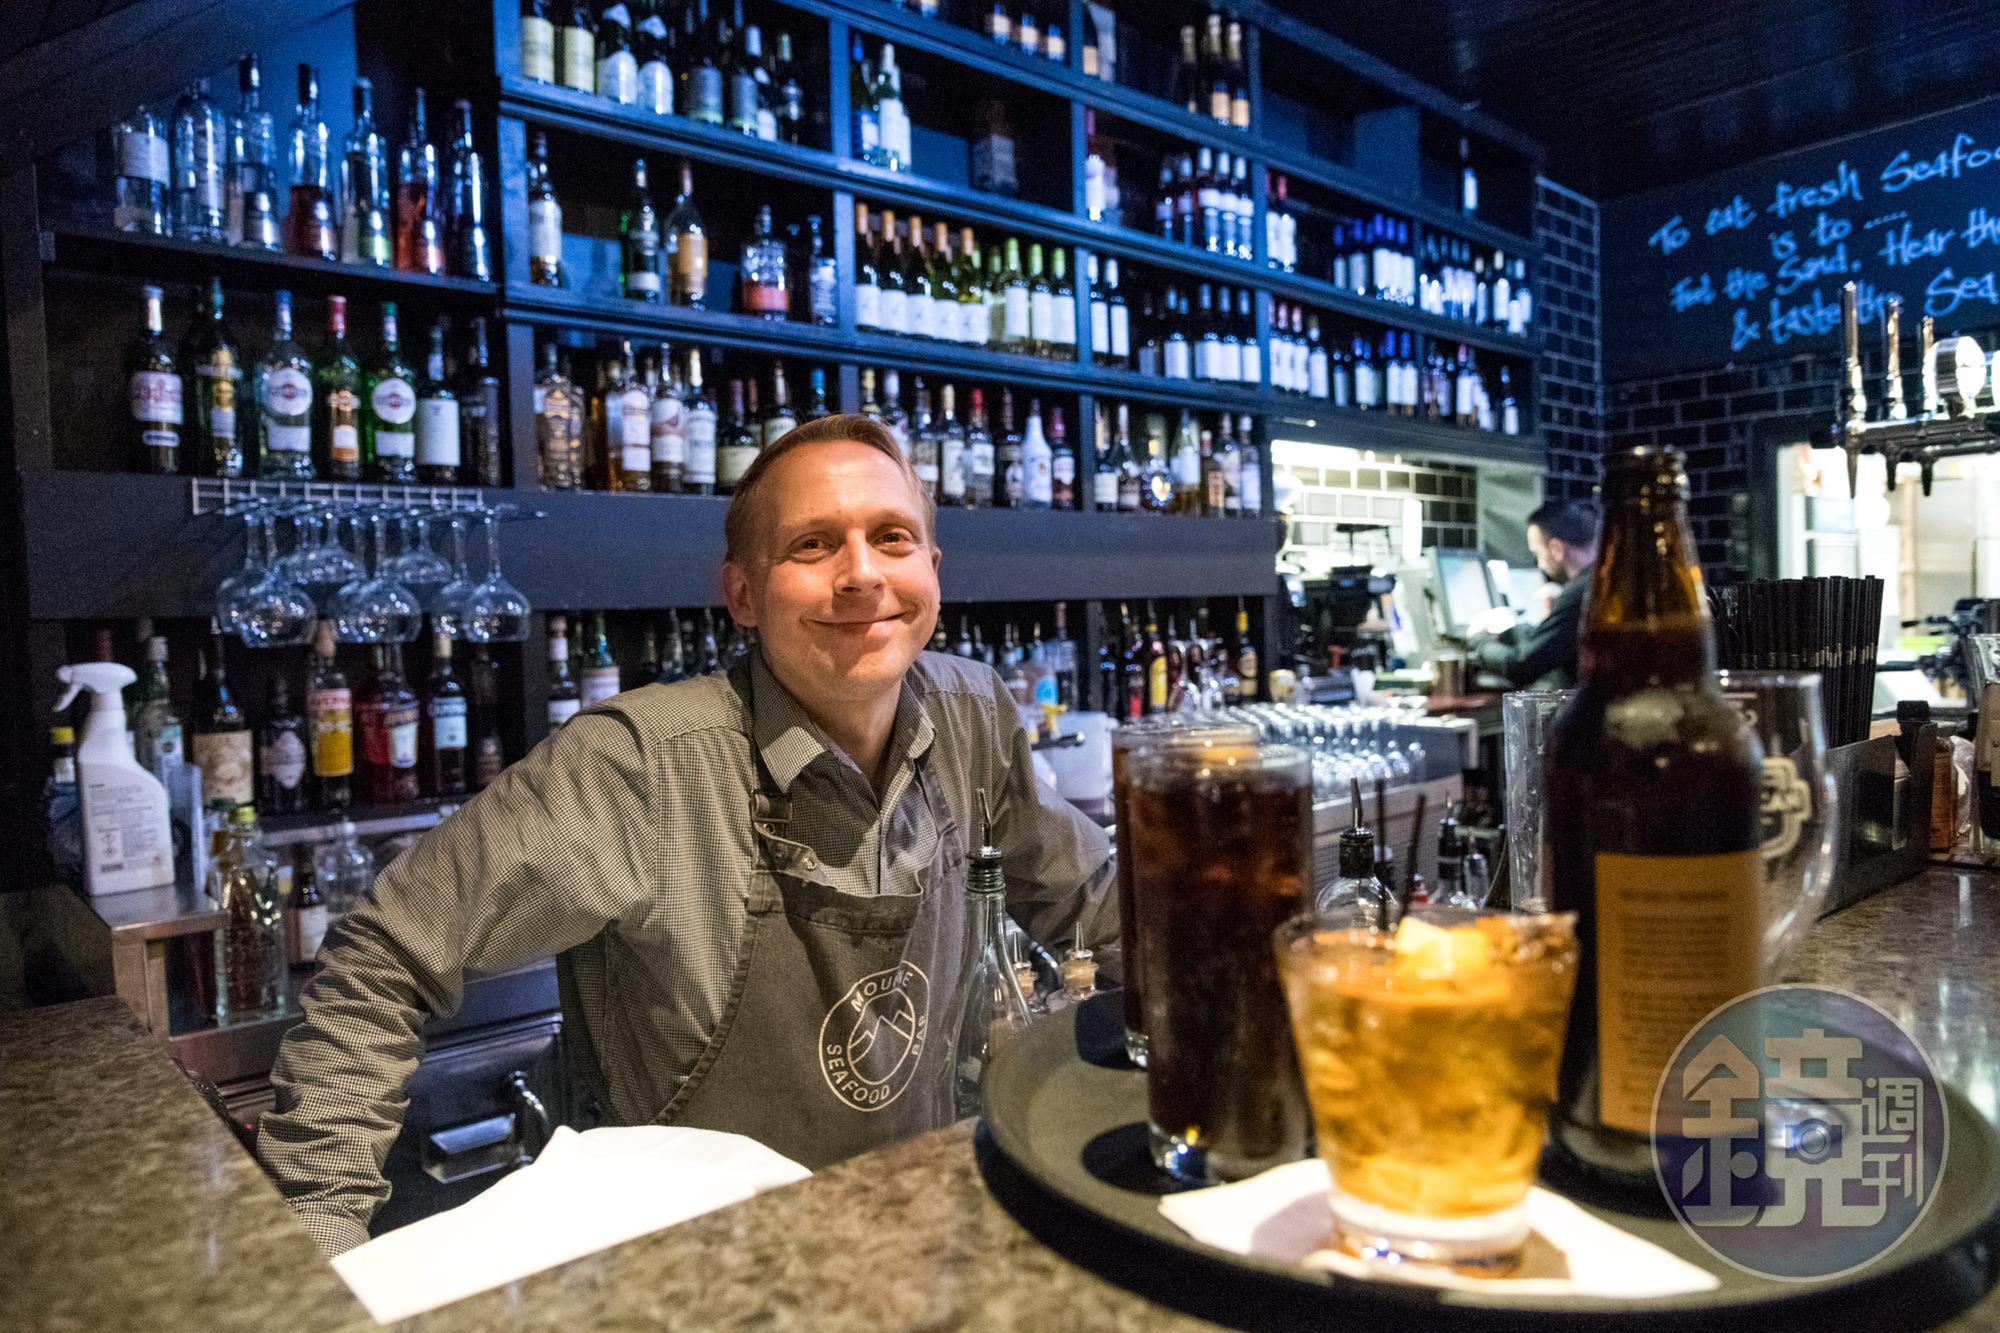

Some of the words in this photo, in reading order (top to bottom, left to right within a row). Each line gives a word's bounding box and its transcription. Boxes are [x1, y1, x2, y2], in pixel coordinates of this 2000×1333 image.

[1649, 215, 1691, 254] To
[1766, 160, 1863, 218] fresh
[1880, 132, 2000, 193] Seafo
[1810, 211, 1852, 247] to
[826, 1043, 890, 1105] SEAFOOD
